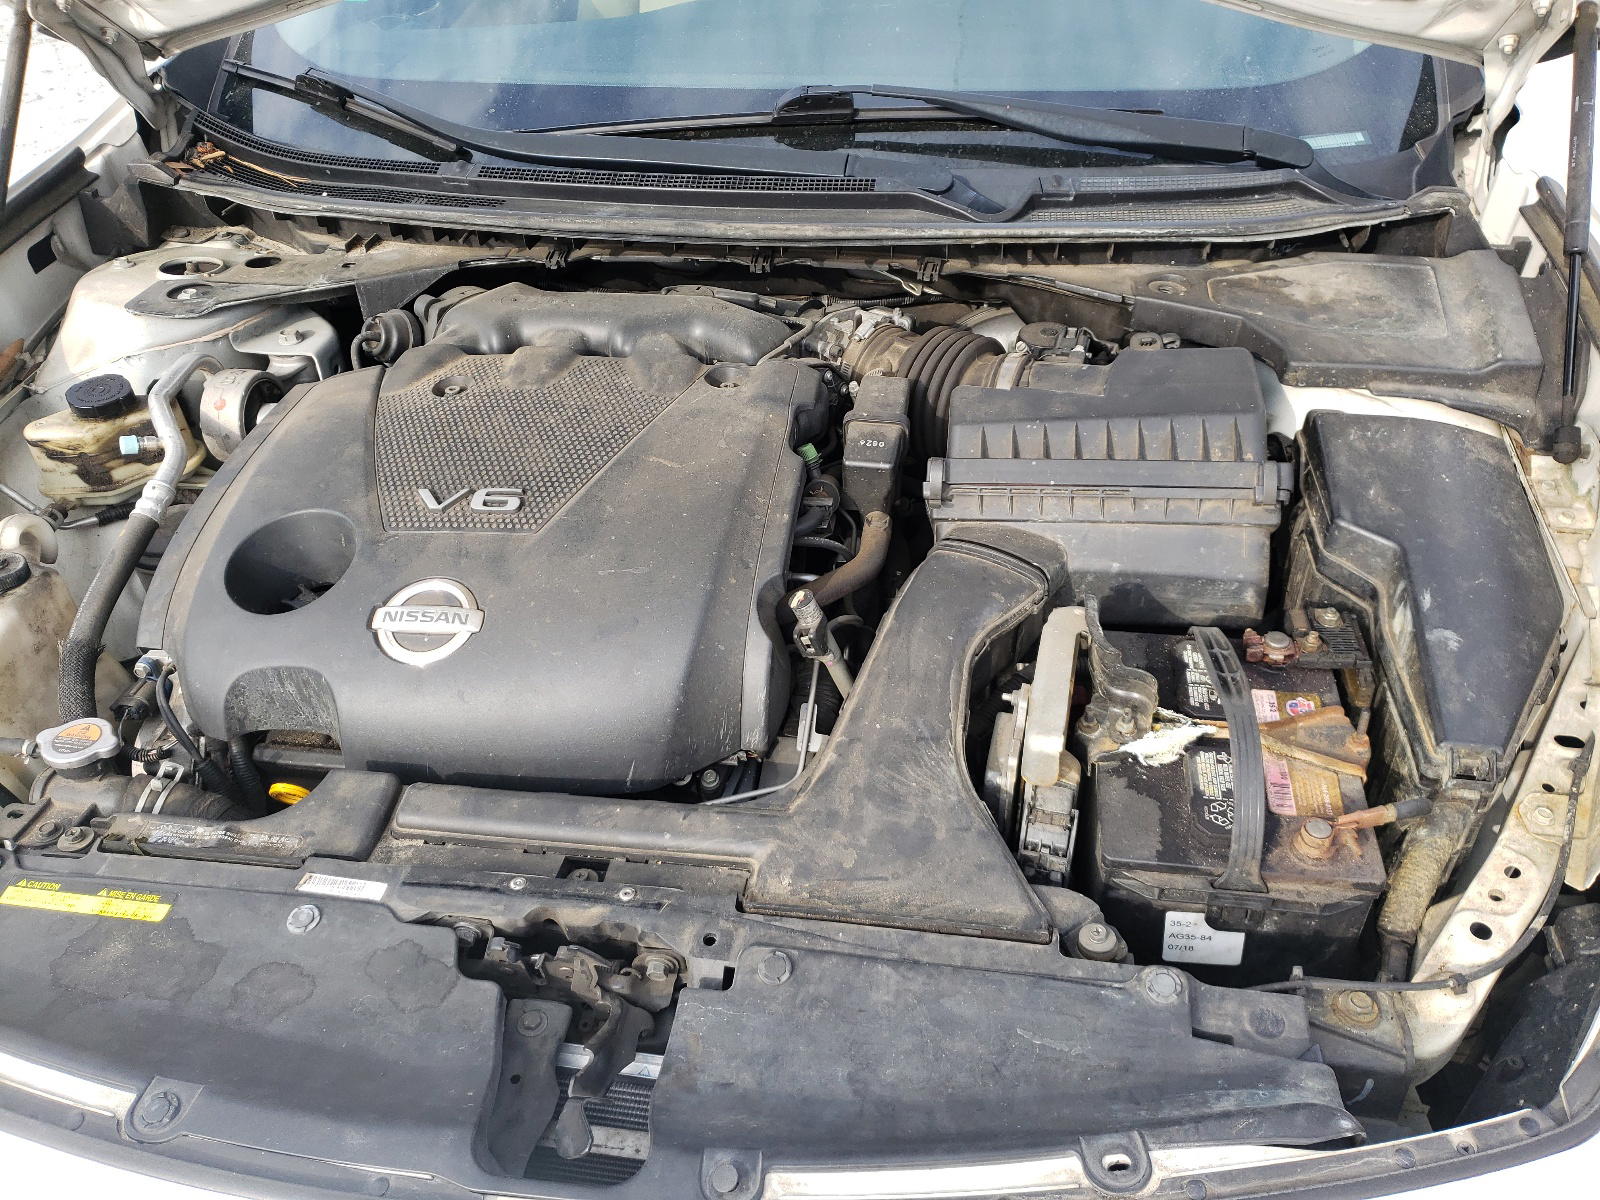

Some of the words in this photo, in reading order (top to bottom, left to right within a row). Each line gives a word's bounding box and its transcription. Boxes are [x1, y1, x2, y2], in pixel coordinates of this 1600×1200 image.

[417, 488, 524, 512] V6
[382, 610, 470, 625] NISSAN
[27, 880, 61, 891] CAUTION
[108, 890, 125, 899] MISE
[126, 892, 137, 900] EN
[137, 893, 161, 903] GARDE
[1168, 932, 1213, 941] AG35-84
